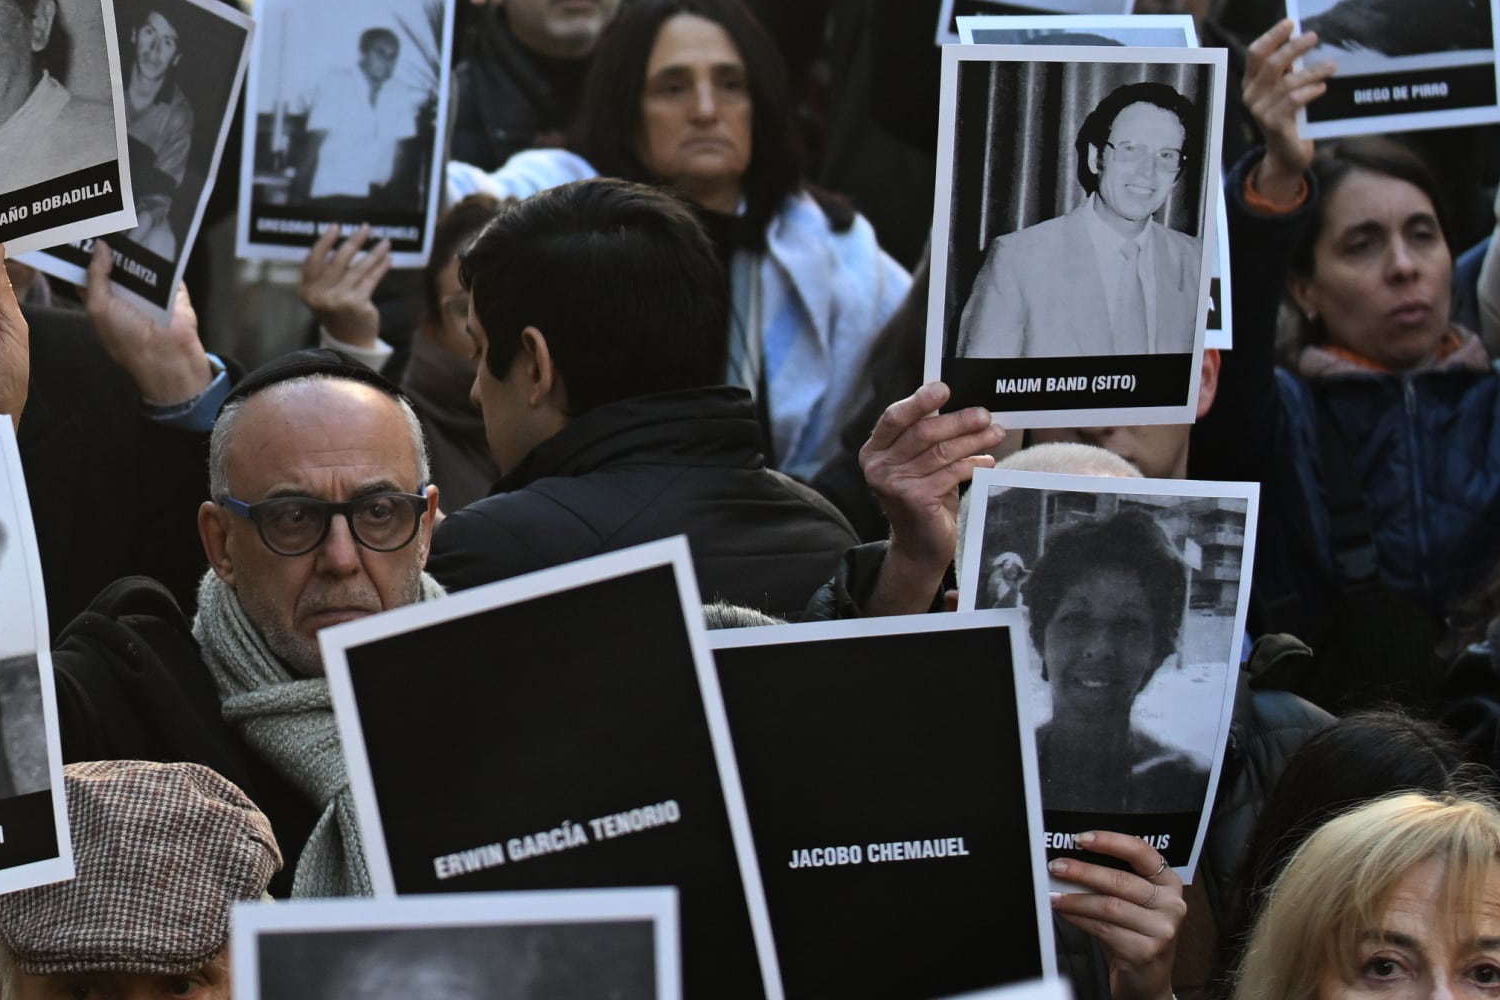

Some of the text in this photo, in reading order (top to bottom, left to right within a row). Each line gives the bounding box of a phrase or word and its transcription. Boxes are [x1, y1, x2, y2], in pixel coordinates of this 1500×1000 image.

[1354, 81, 1449, 104] DIEGO DE PIRRO
[32, 180, 113, 214] BOBADILLA
[996, 374, 1137, 394] NAUM BAND (SITO)
[433, 799, 681, 880] ERWIN GARCÍA TENORIO
[788, 837, 970, 869] JACOBO CHEMAUEL
